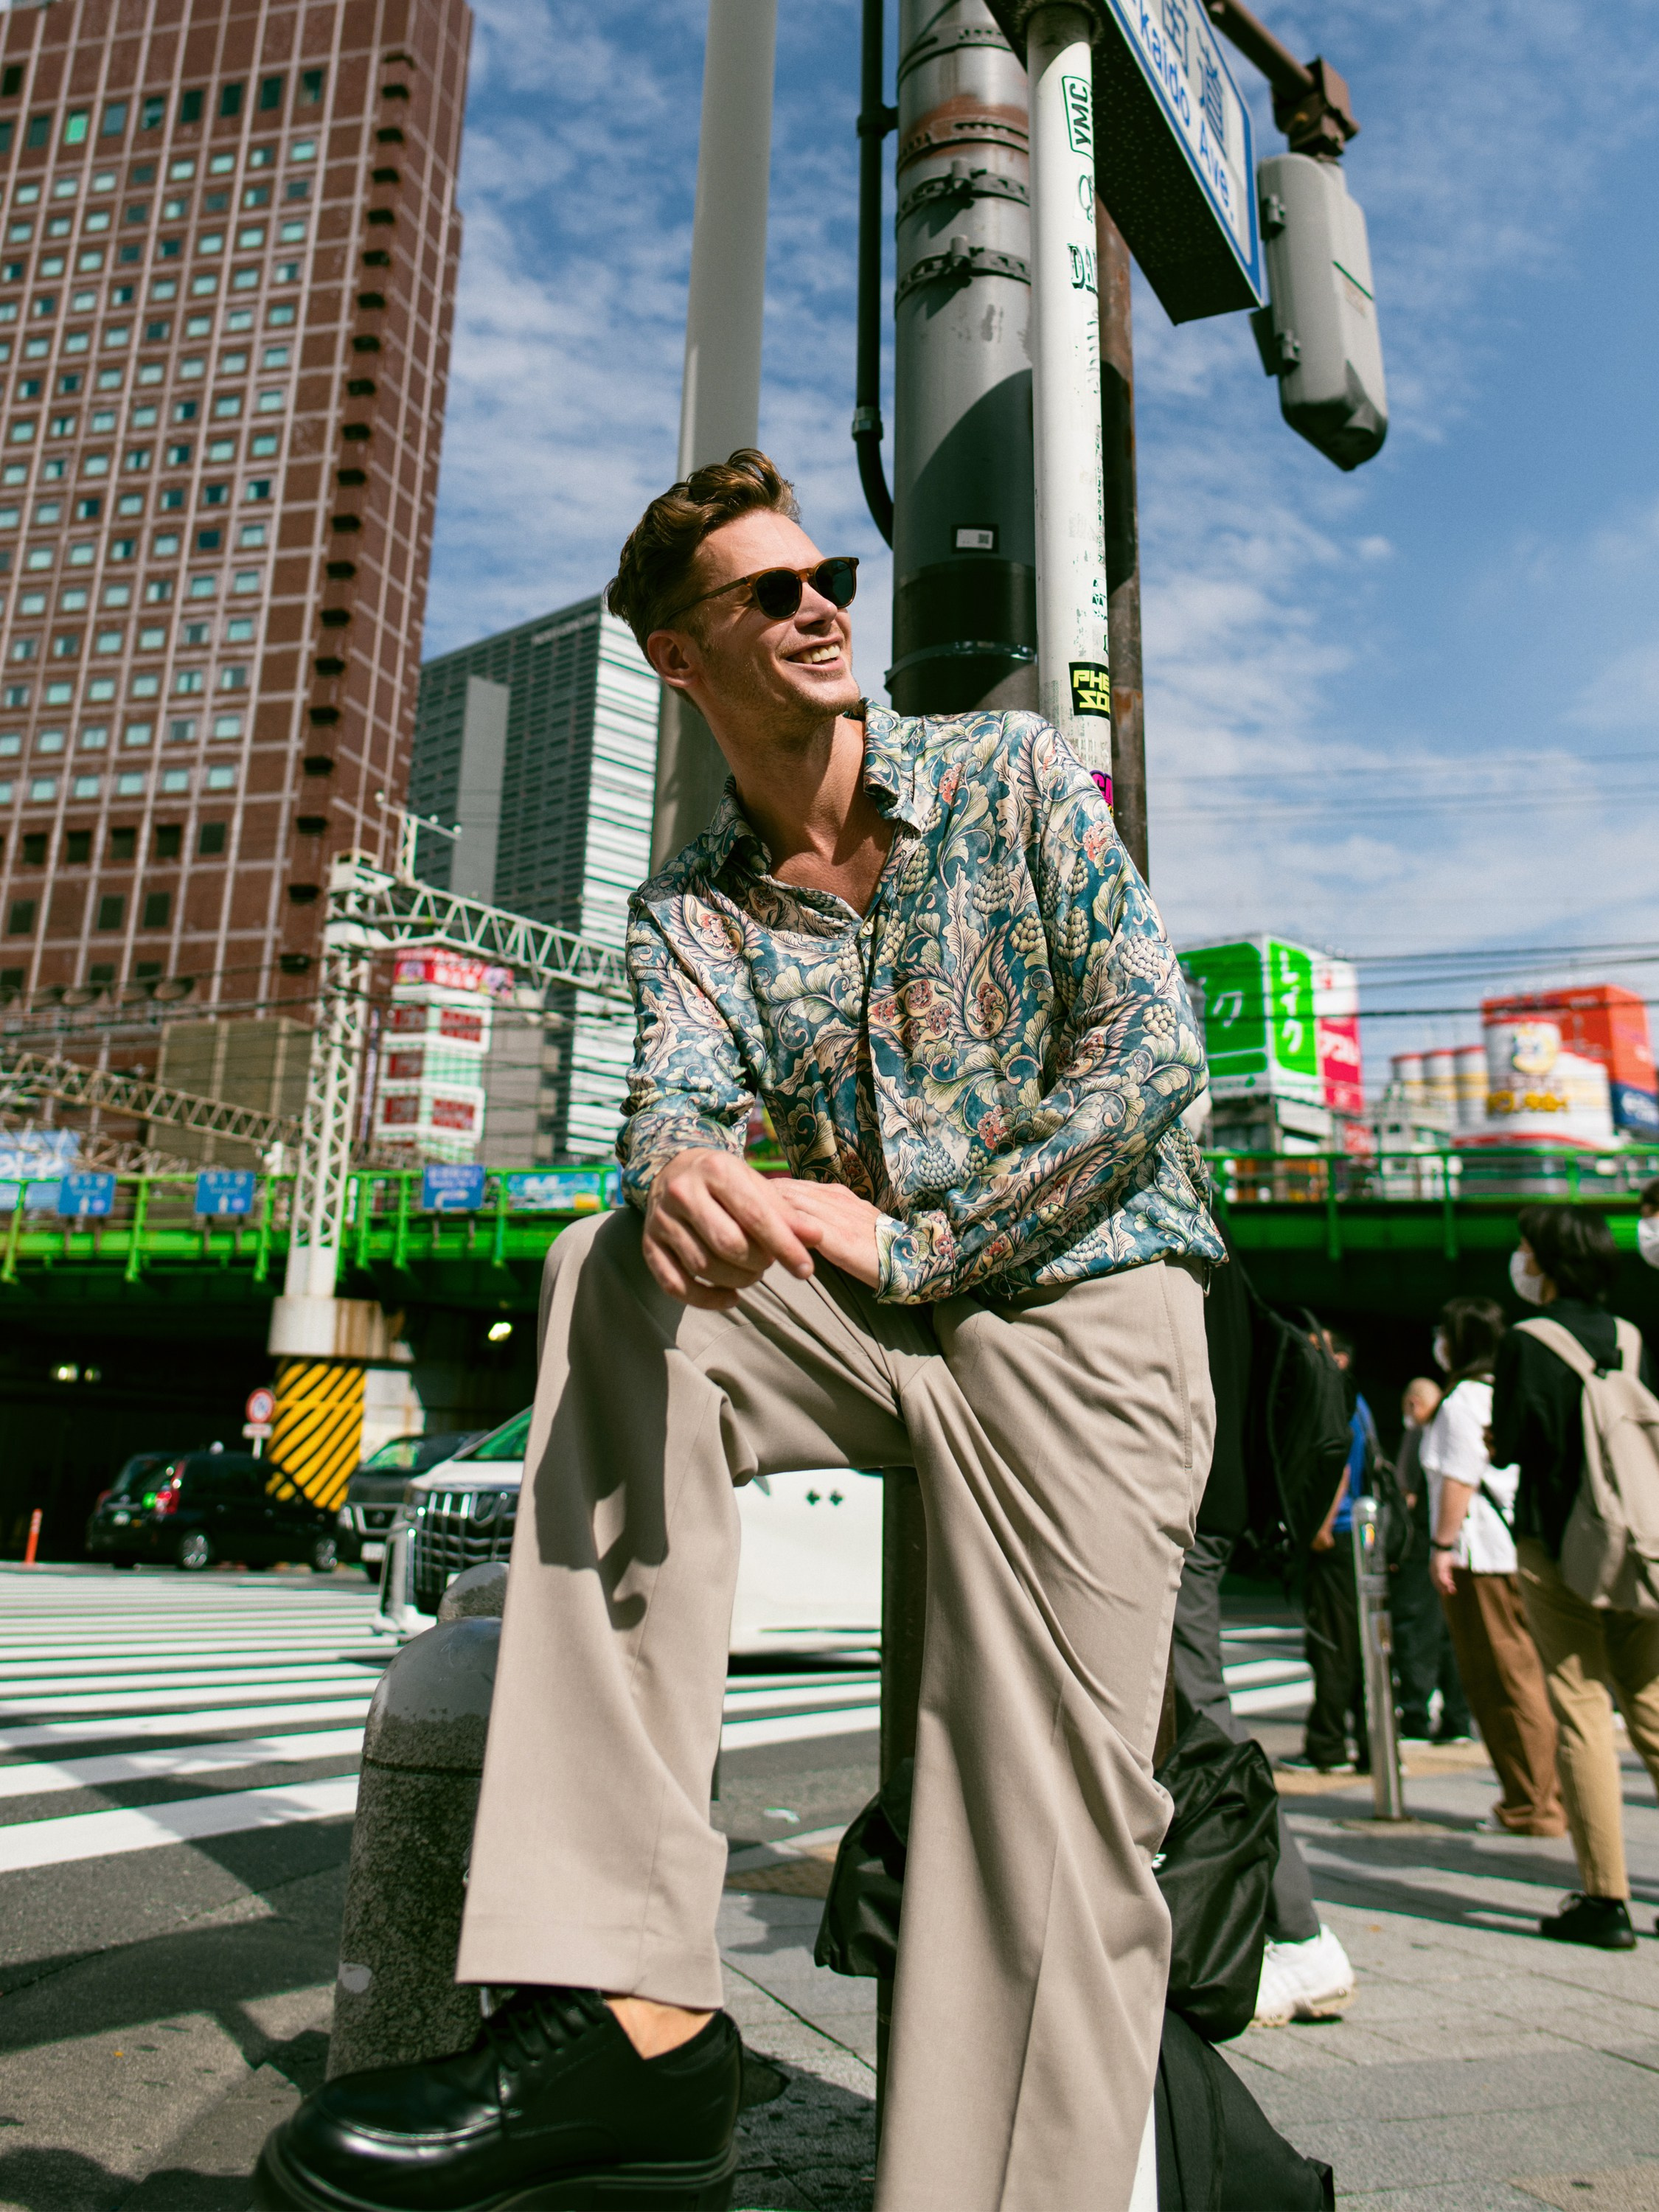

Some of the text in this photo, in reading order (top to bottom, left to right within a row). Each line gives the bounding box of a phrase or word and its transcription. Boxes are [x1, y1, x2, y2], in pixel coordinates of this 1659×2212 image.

[1069, 83, 1091, 145] YMC
[1200, 119, 1234, 222] Ave.
[1279, 950, 1303, 1054] レイク
